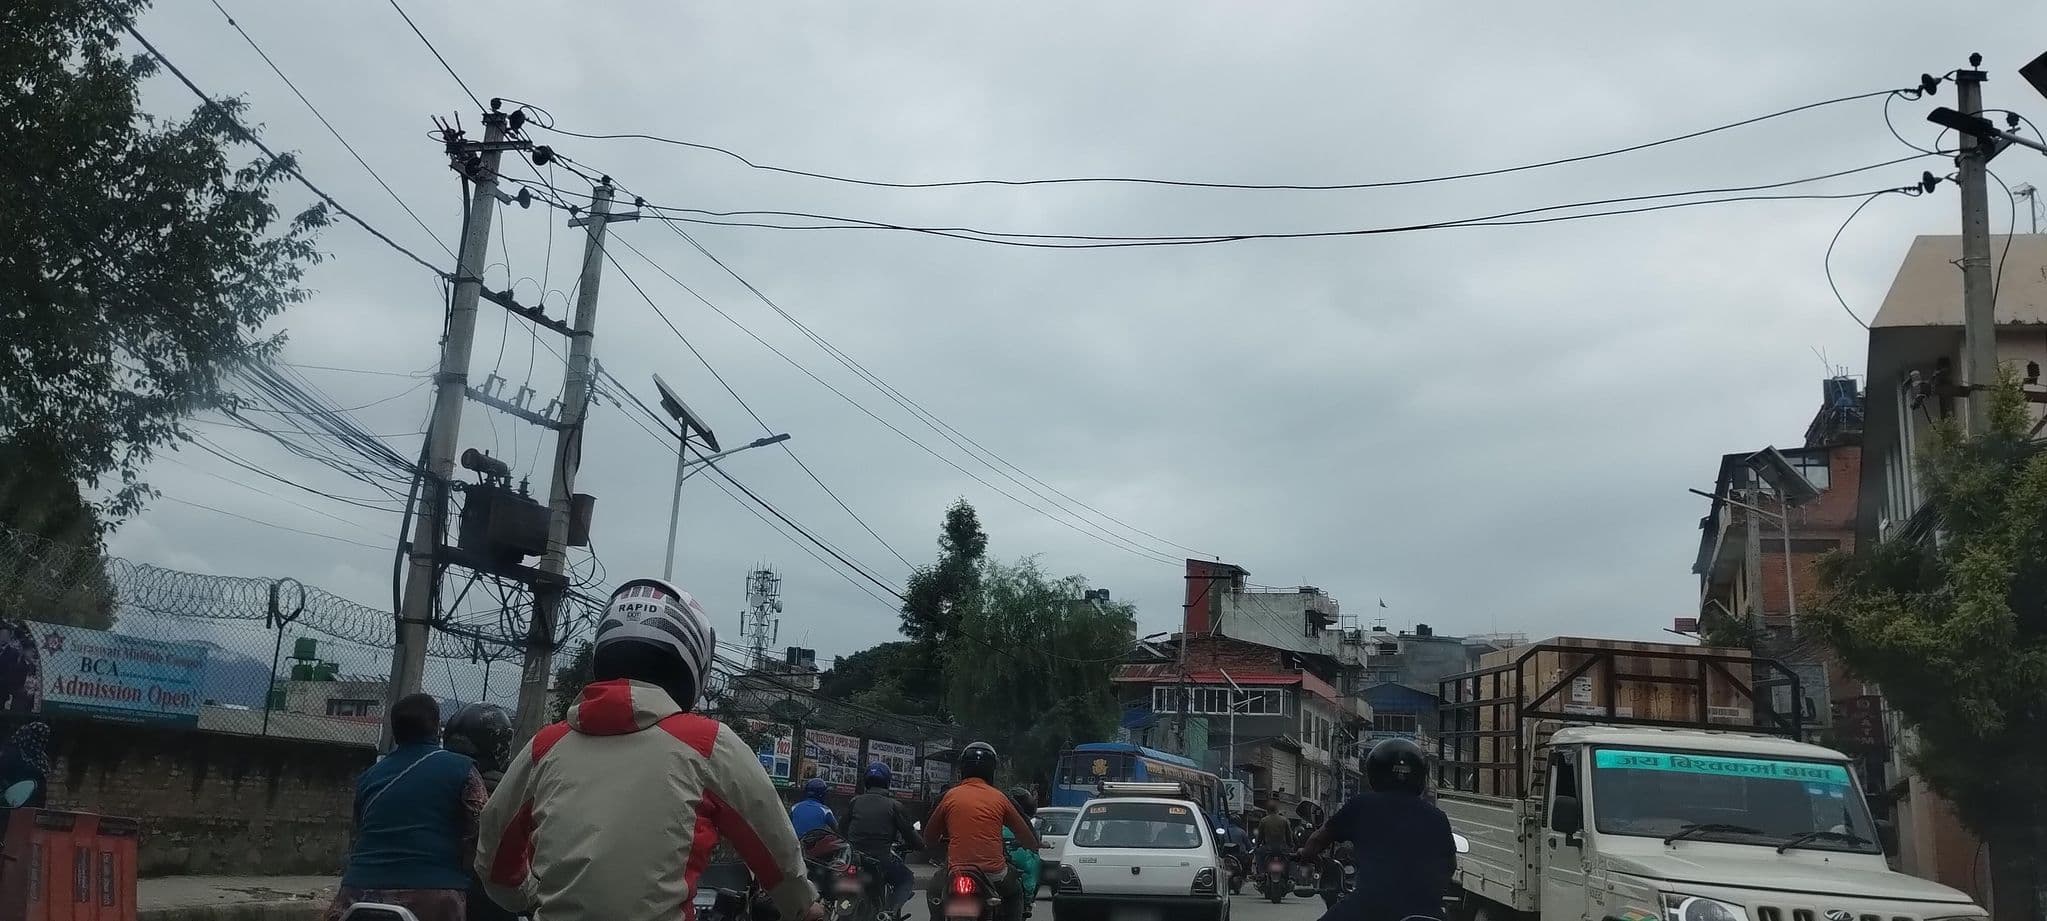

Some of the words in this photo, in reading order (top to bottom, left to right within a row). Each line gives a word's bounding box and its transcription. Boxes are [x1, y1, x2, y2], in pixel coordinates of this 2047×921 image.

[618, 603, 657, 613] RAPID
[79, 656, 119, 677] BCA
[51, 674, 142, 702] Admission
[1616, 754, 1659, 767] जय
